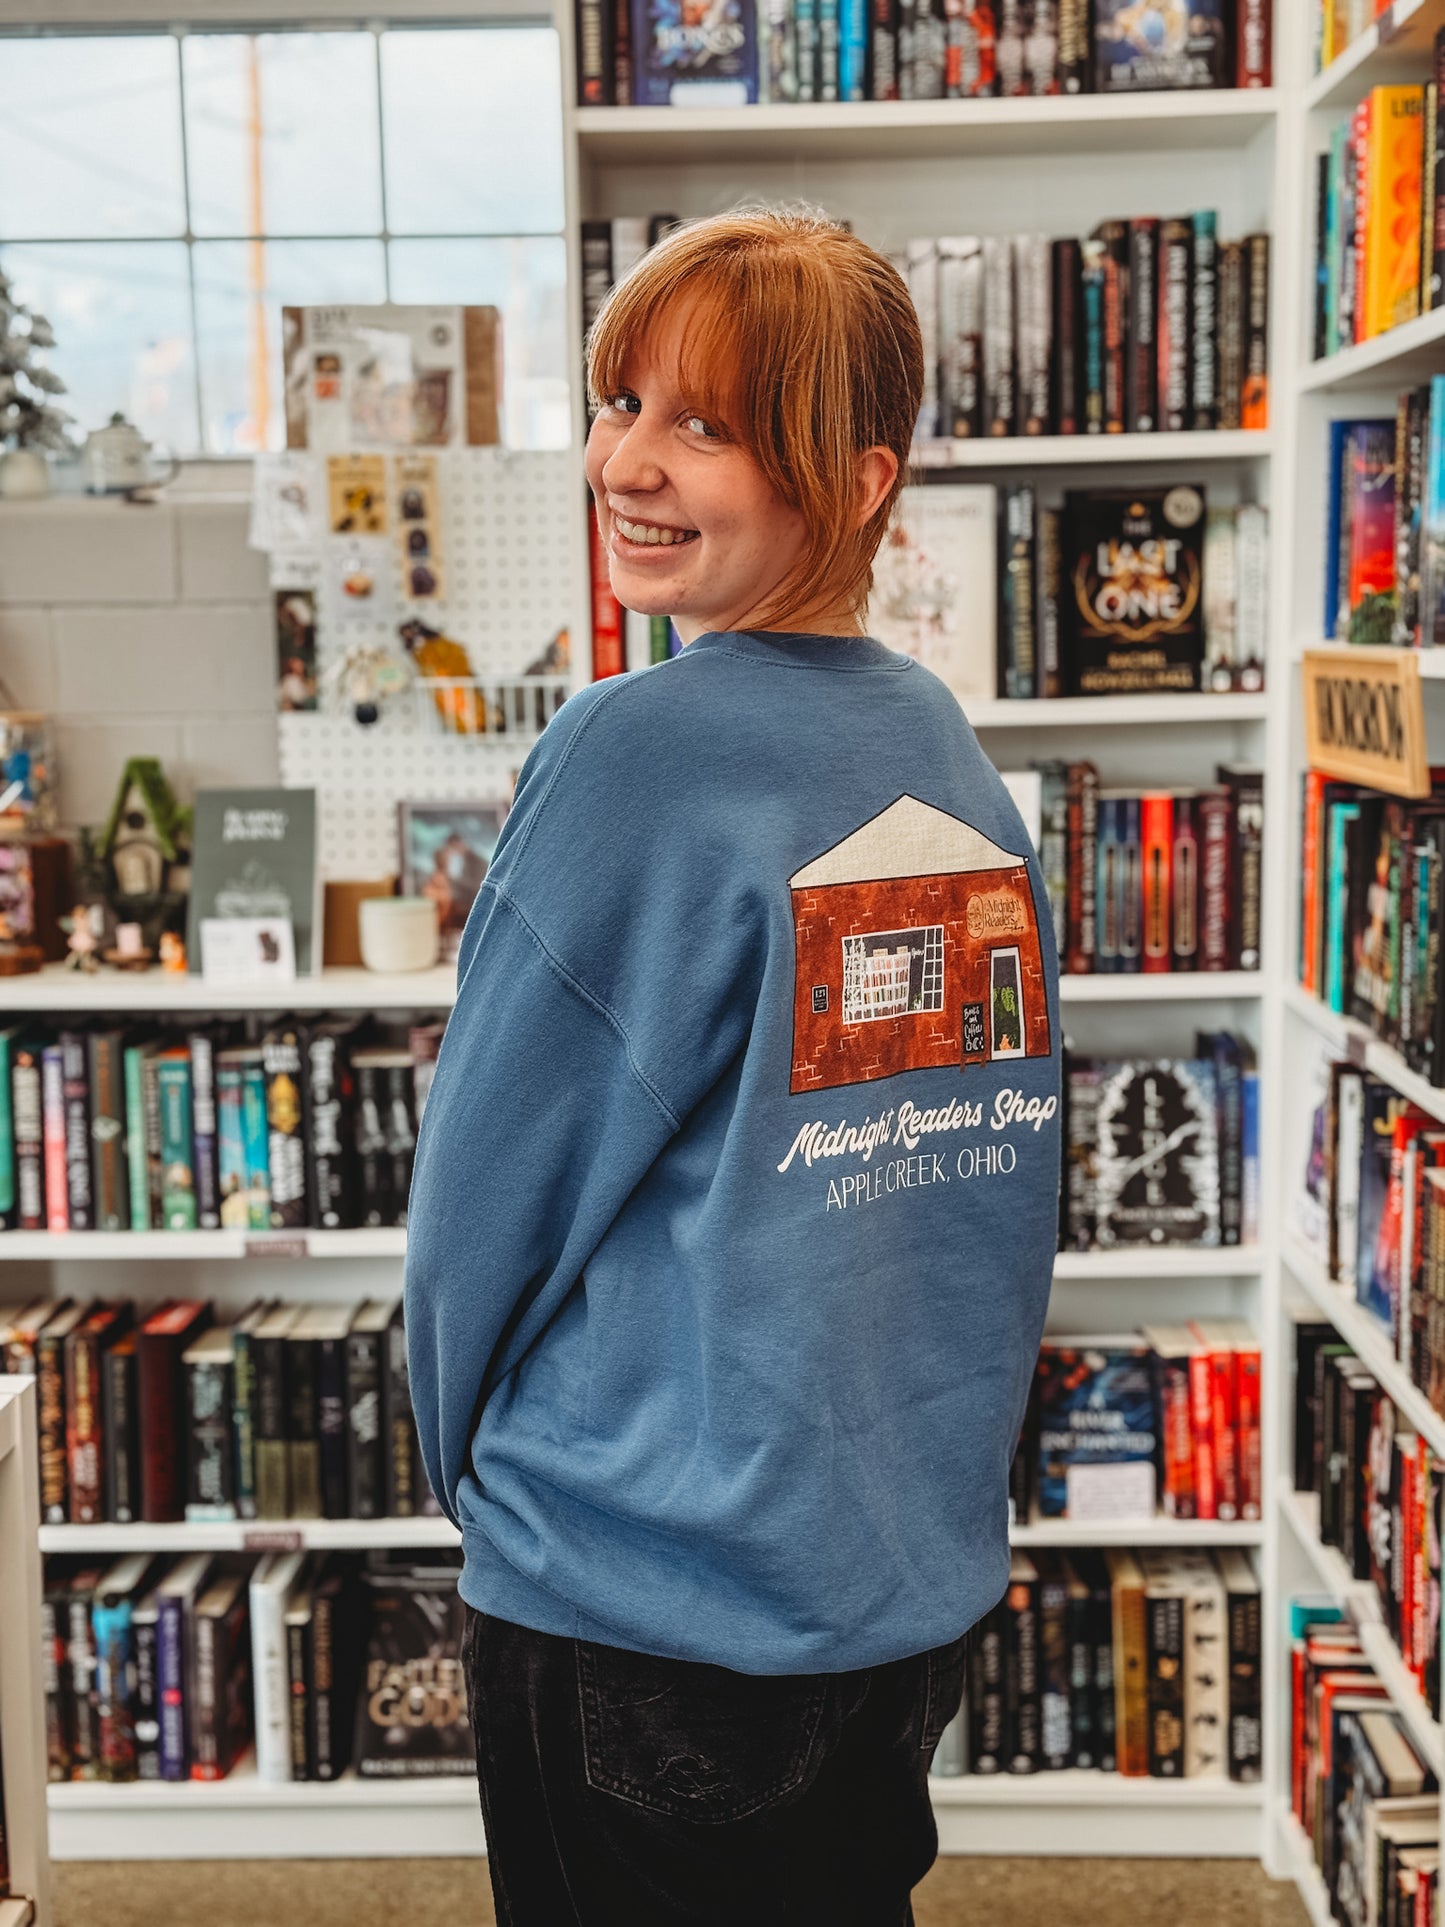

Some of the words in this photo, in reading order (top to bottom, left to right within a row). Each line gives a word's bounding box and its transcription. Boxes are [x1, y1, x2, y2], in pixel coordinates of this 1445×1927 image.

[1097, 538, 1183, 577] LAST
[1095, 584, 1182, 620] ONE
[986, 898, 1022, 914] Midnight
[777, 1106, 893, 1173] Midnight
[893, 1096, 983, 1151] Readers
[989, 1087, 1057, 1133] Shop
[826, 1164, 883, 1212] APPLE
[885, 1153, 951, 1193] CREEK,
[957, 1143, 1016, 1179] OHIO
